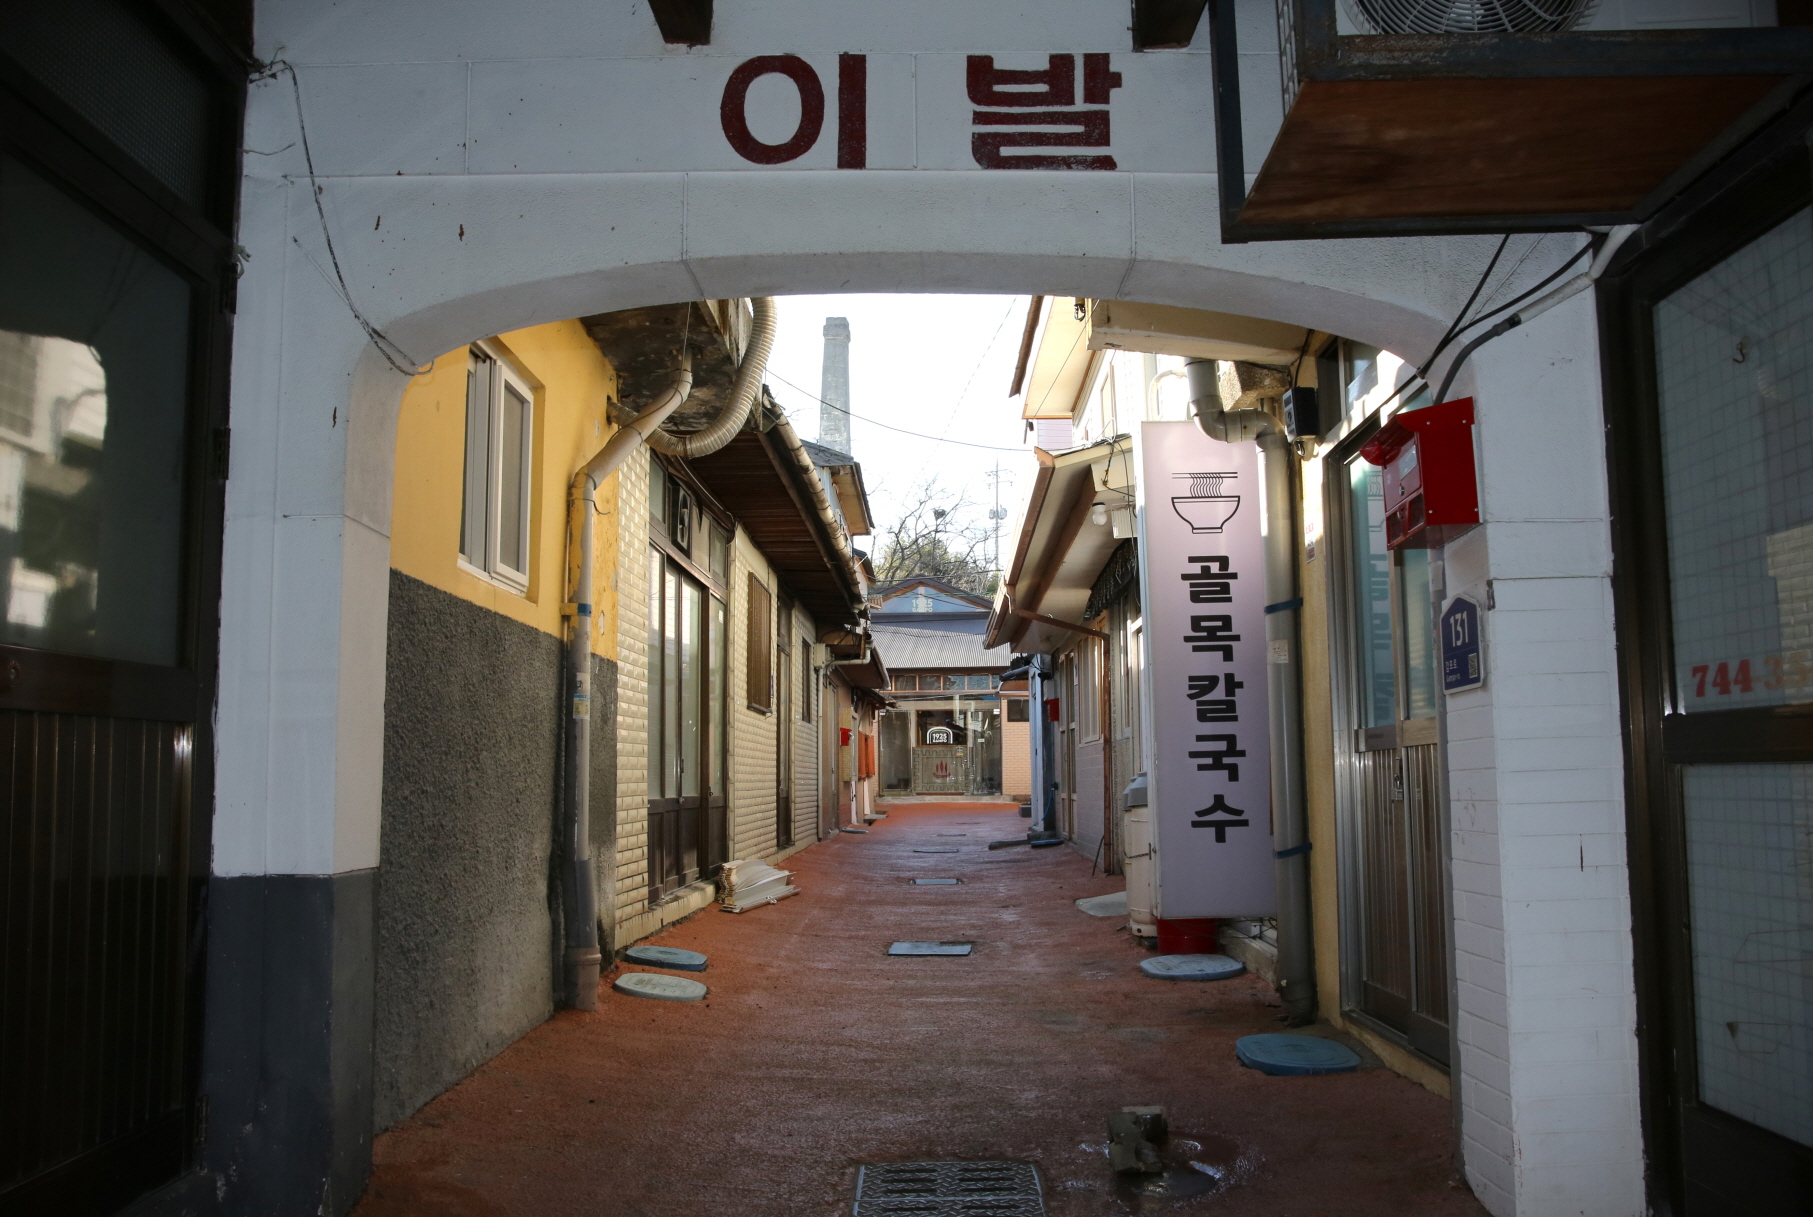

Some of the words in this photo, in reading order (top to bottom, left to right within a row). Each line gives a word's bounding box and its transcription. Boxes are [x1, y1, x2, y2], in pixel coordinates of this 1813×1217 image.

[912, 599, 933, 608] 1925
[1449, 610, 1469, 648] 131
[1445, 659, 1458, 673] 감포로
[1181, 556, 1249, 843] 골목칼국수
